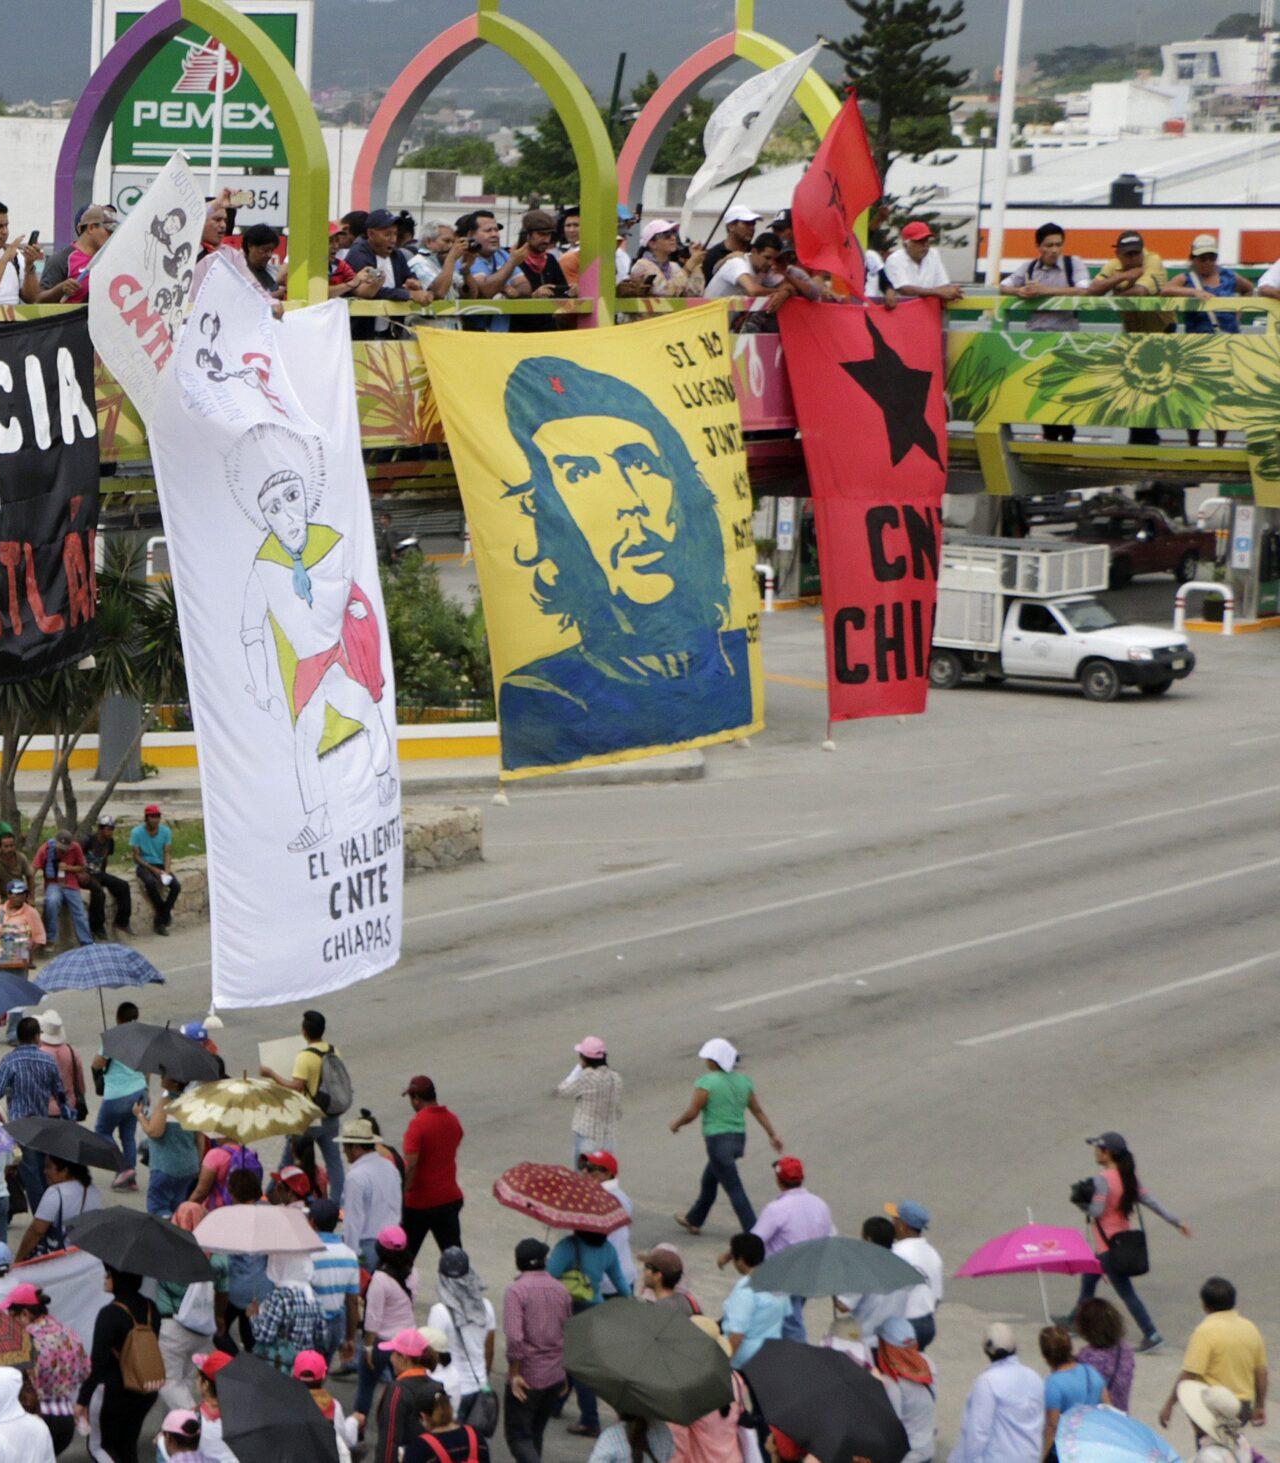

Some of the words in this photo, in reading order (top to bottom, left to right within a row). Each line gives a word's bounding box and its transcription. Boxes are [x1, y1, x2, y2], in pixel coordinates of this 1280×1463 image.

[132, 101, 275, 130] PEMEX
[666, 342, 696, 368] SI
[865, 504, 943, 582] CN
[833, 599, 937, 685] CHI
[308, 851, 330, 880] EL
[329, 862, 389, 920] CNTE
[322, 915, 391, 962] CHIAPAS
